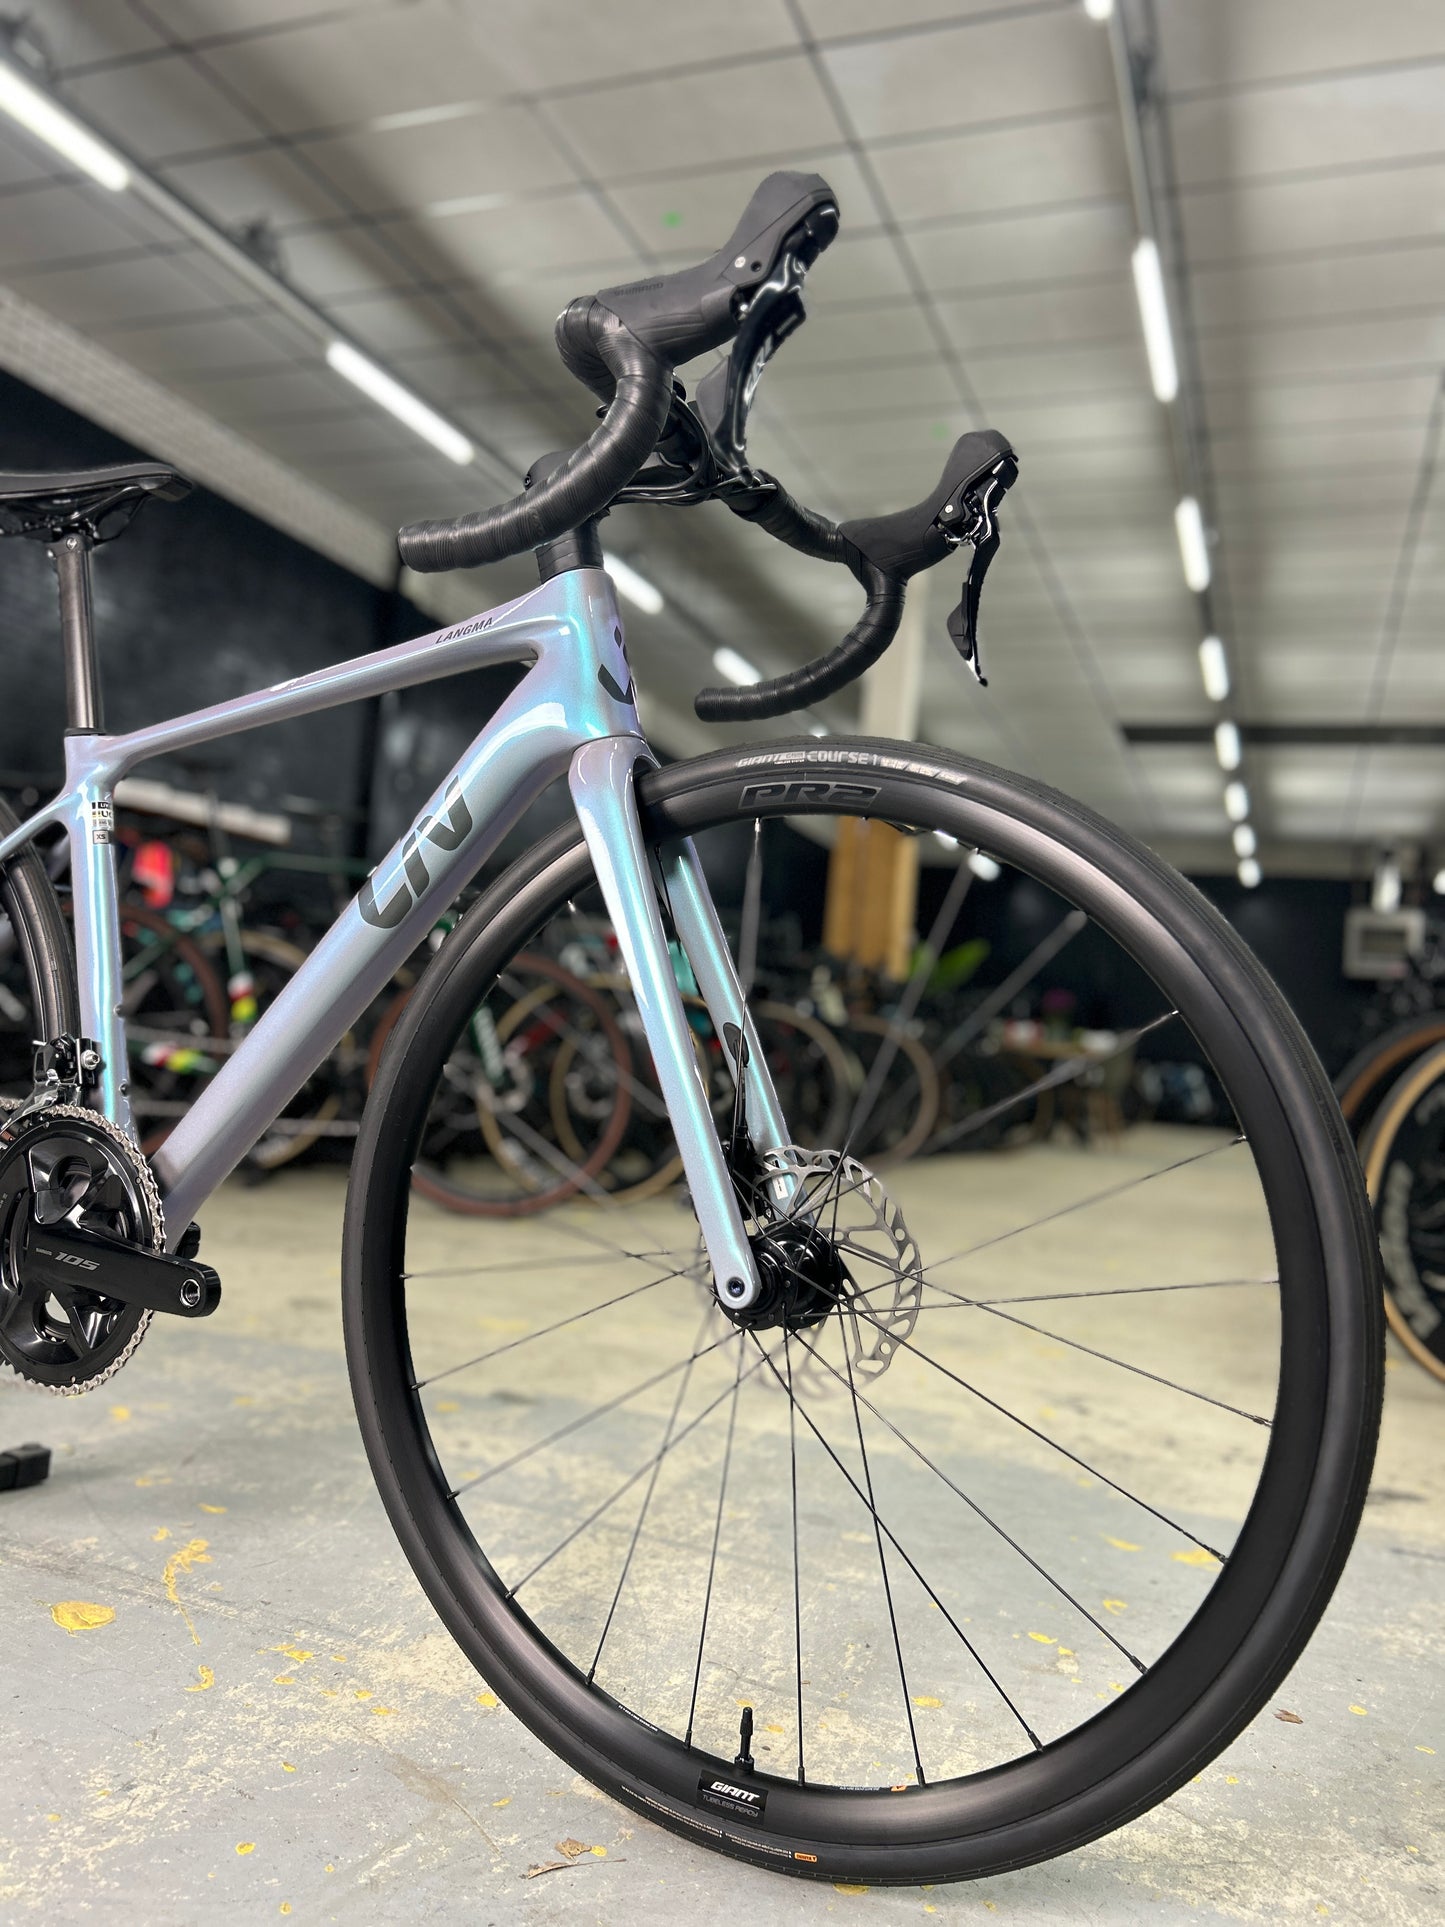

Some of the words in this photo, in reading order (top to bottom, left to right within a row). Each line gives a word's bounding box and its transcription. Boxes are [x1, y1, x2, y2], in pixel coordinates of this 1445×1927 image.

[434, 616, 494, 645] LANGMA
[737, 752, 783, 768] GIANT
[738, 780, 882, 810] PR2
[55, 1251, 100, 1271] 105
[710, 1781, 760, 1802] GIANT
